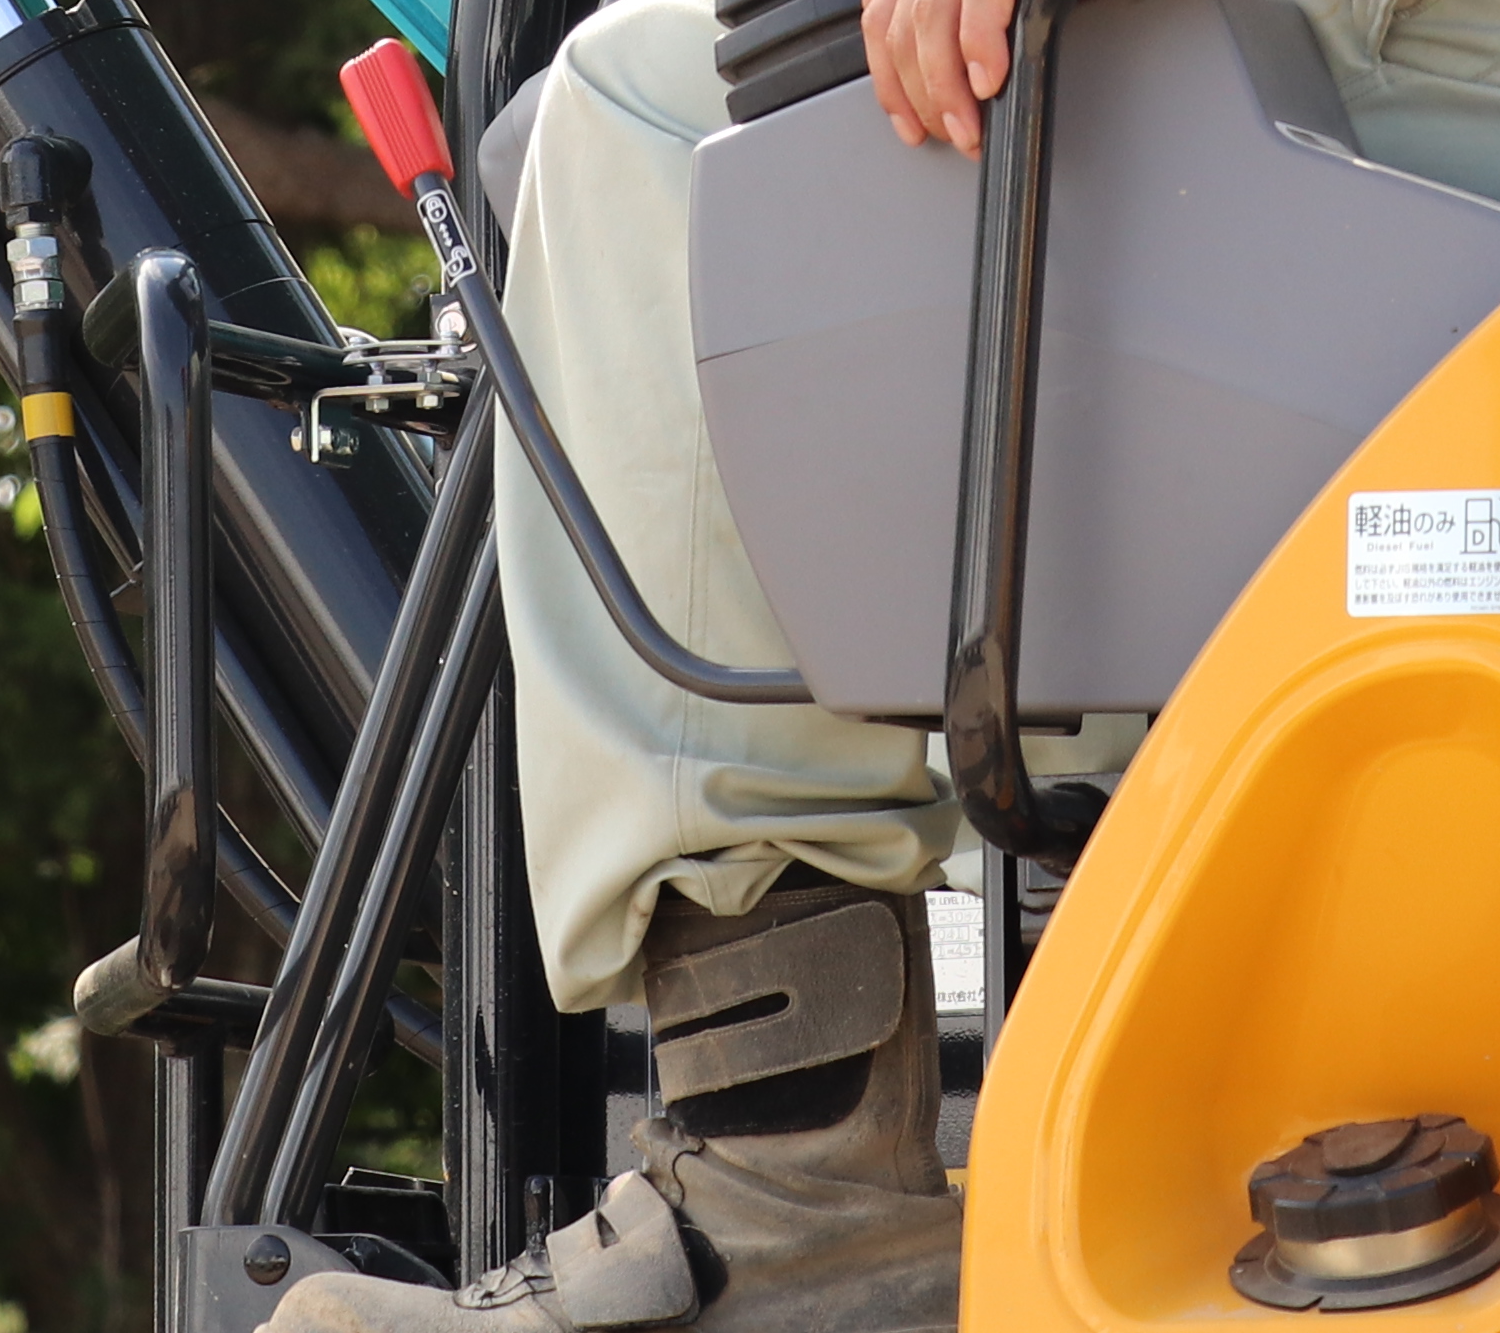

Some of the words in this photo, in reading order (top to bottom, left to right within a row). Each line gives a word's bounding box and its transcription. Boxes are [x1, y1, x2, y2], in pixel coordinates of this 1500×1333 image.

[1355, 503, 1457, 539] 軽油のみ
[1366, 541, 1402, 553] Diesel
[1409, 540, 1434, 552] Fuel
[1472, 529, 1485, 547] D
